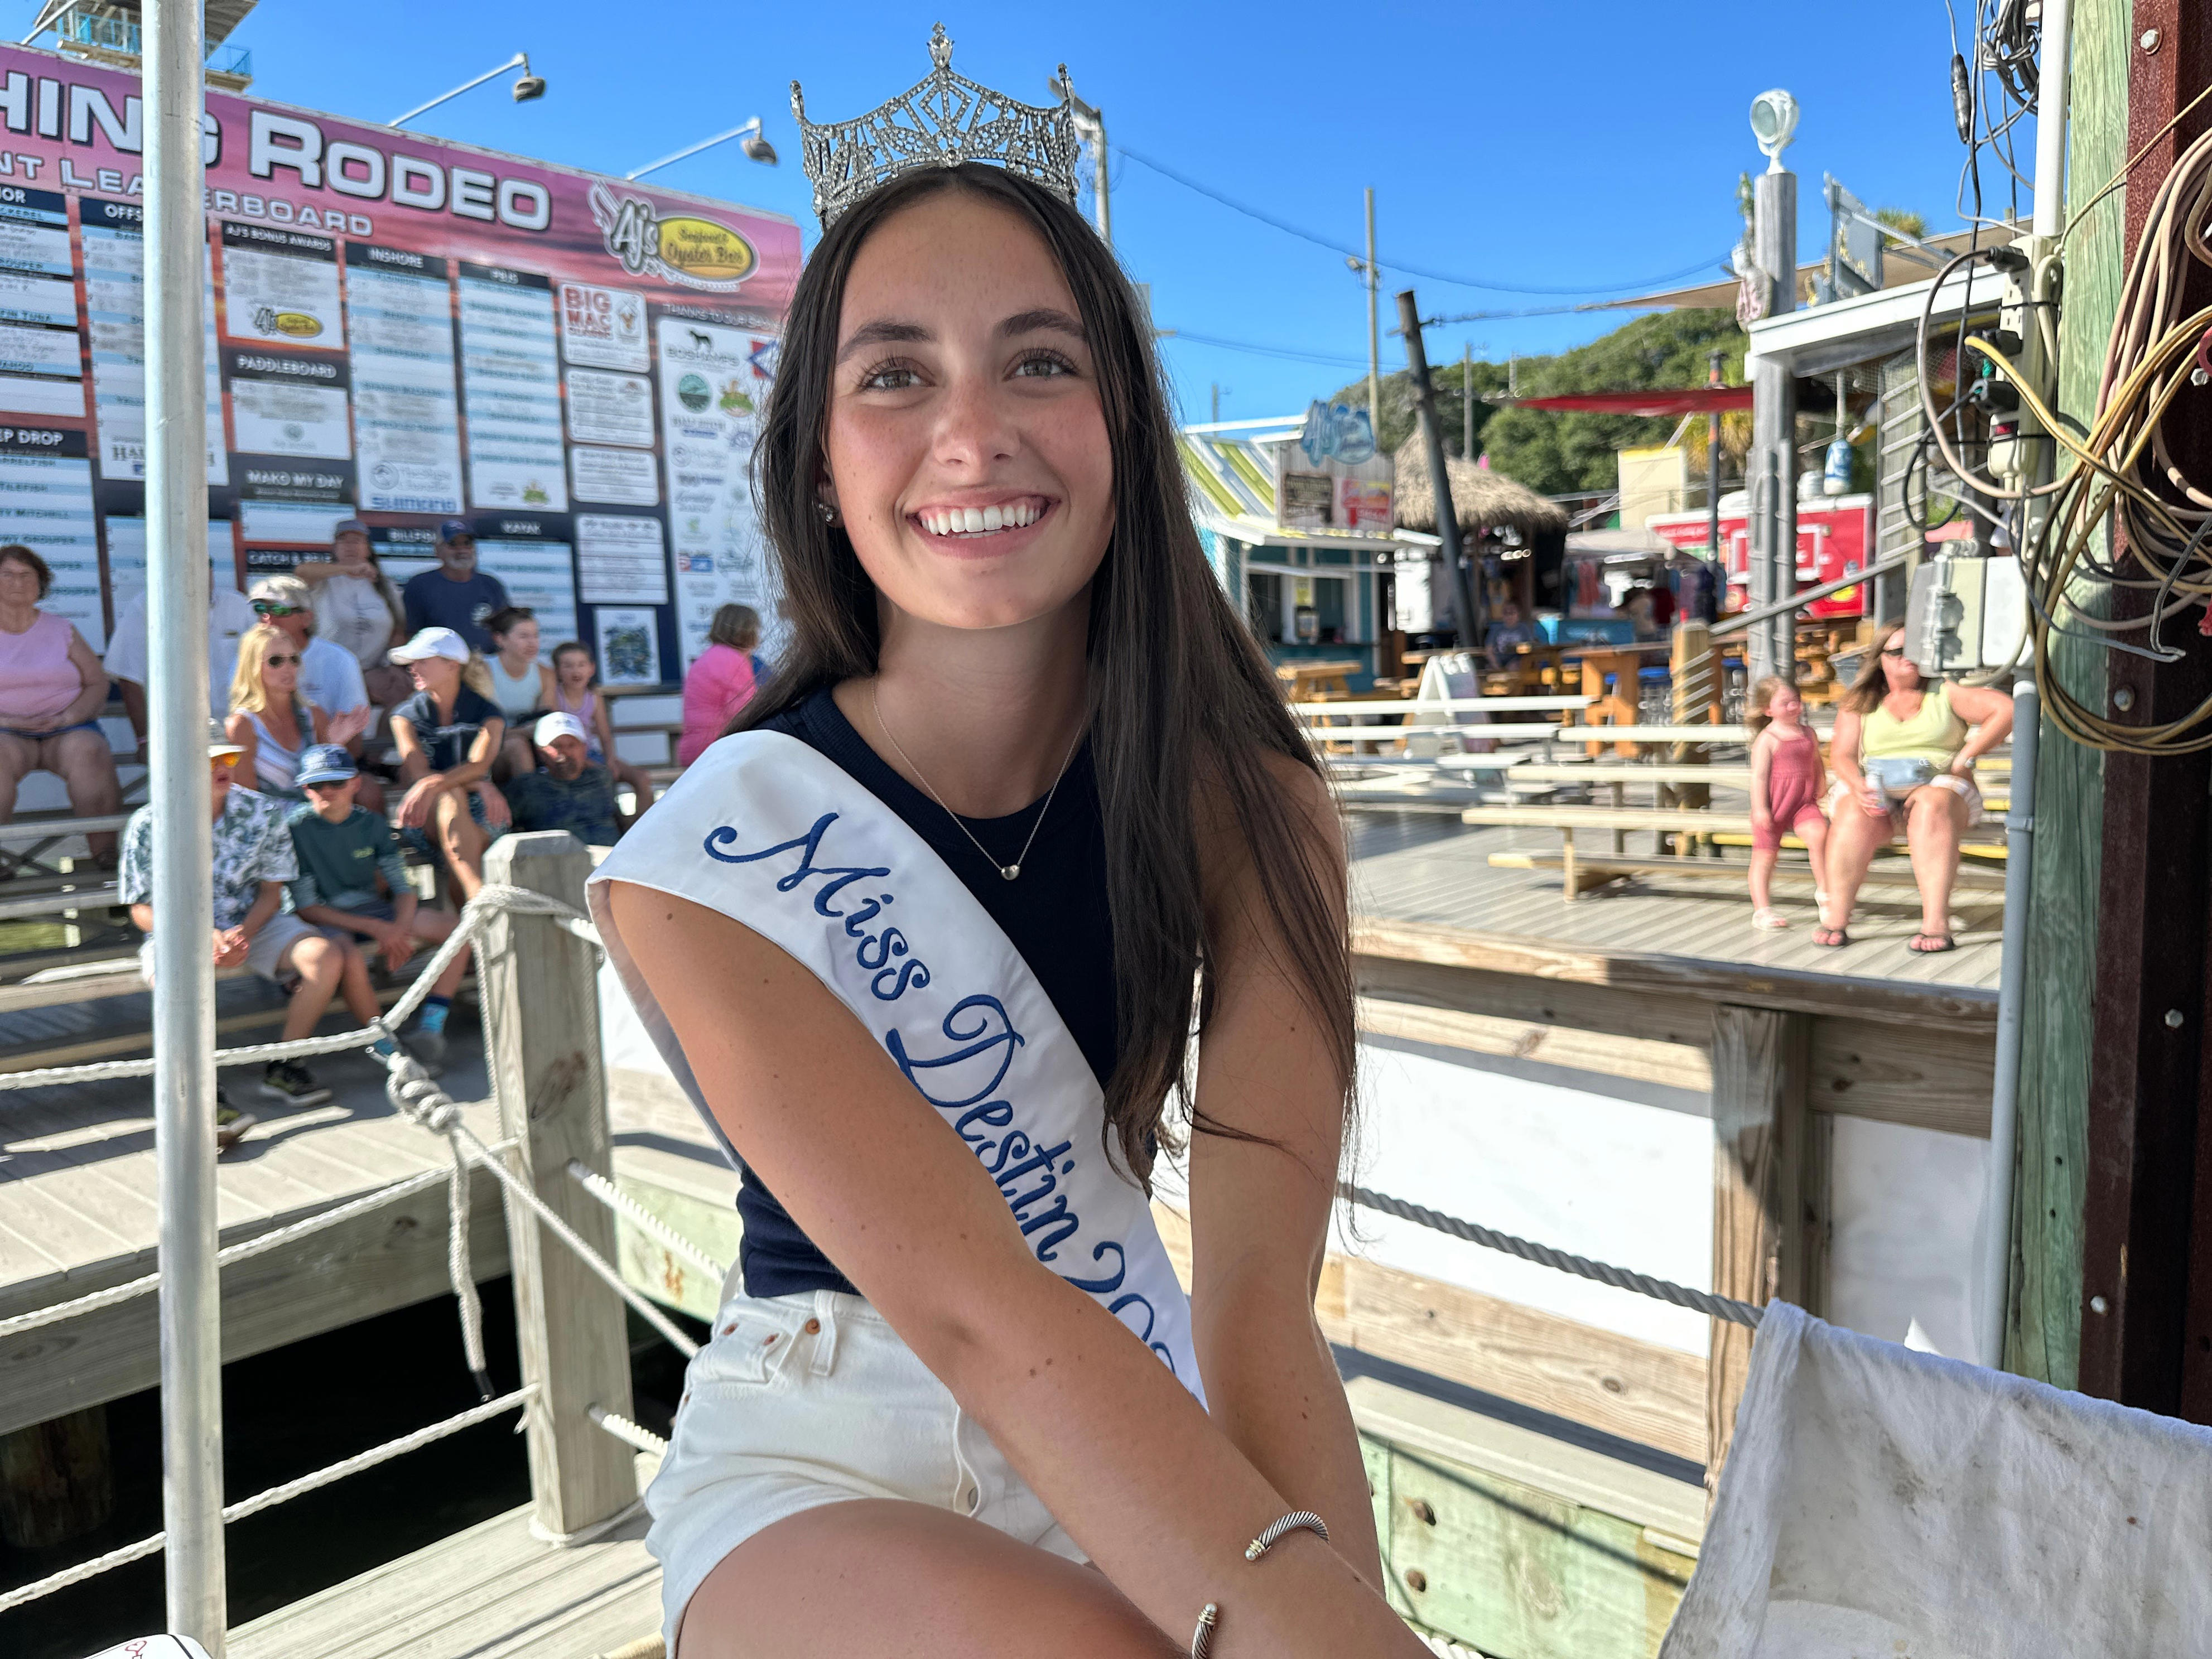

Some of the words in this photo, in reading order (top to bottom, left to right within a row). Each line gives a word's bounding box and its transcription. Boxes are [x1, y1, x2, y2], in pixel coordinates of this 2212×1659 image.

[0, 70, 221, 167] HIN
[250, 110, 550, 231] RODEO
[0, 186, 26, 203] OR
[59, 158, 373, 237] LEARBOARD
[289, 234, 332, 251] AWARDS
[367, 248, 424, 268] INSHORE
[565, 288, 611, 313] BIG
[567, 310, 611, 330] MAC
[236, 354, 336, 379] PADDLEBOARD
[18, 430, 64, 446] DROP
[245, 469, 291, 486] MAKO
[292, 472, 314, 488] MY
[315, 474, 344, 489] DAY
[247, 551, 290, 566] CATCH
[703, 812, 931, 1001] Miss
[885, 994, 1080, 1262] Destin
[1063, 1240, 1176, 1376] 20
